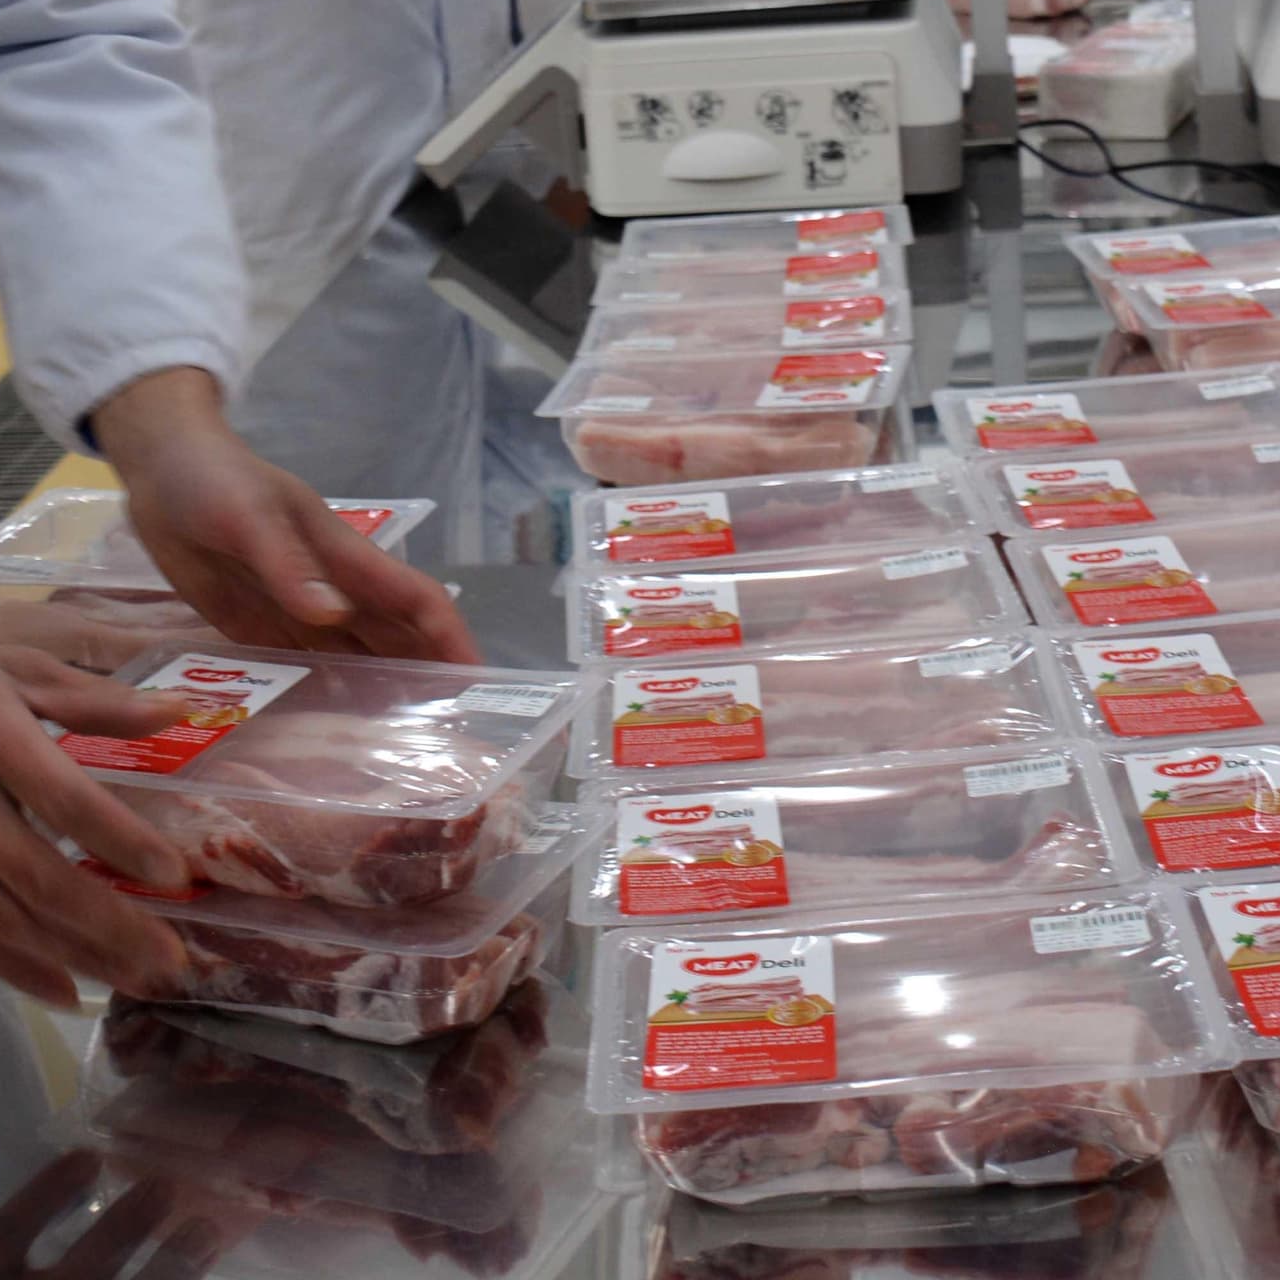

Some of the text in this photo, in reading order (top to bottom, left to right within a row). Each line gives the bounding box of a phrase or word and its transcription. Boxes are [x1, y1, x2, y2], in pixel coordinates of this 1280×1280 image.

[1163, 759, 1218, 775] MEAT
[653, 807, 755, 821] MEAT Deli
[692, 956, 806, 972] MEAT Deli
